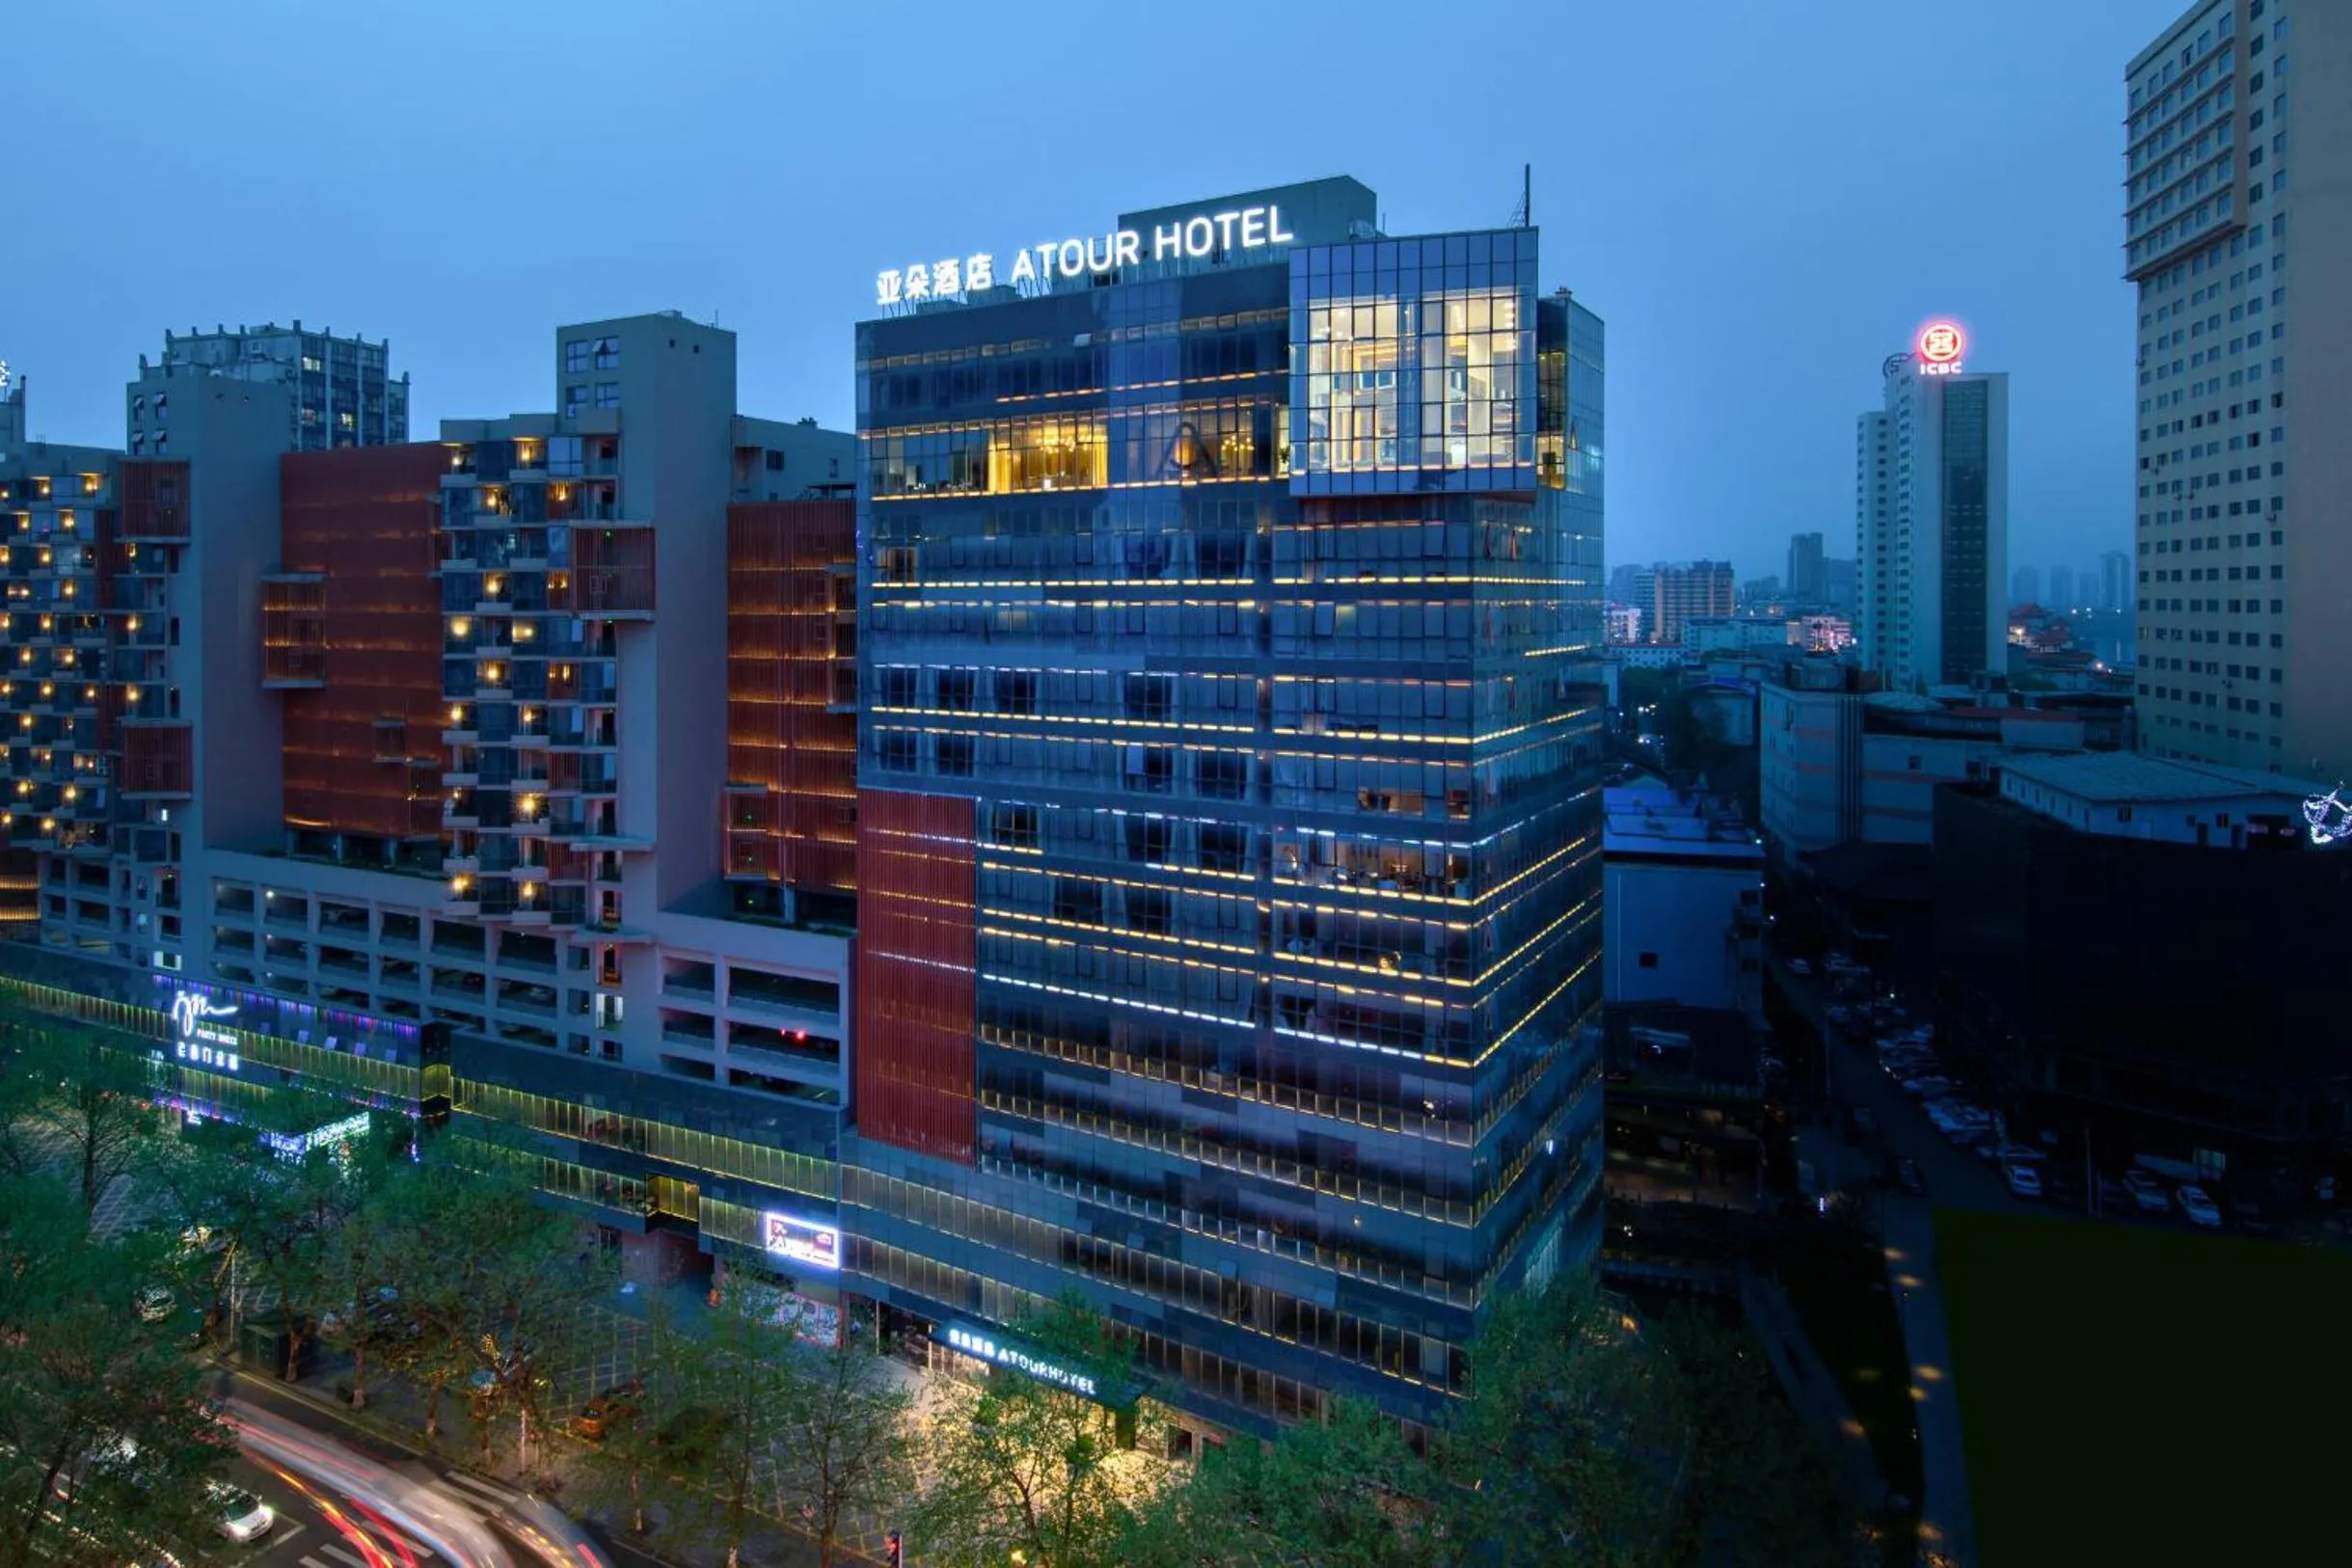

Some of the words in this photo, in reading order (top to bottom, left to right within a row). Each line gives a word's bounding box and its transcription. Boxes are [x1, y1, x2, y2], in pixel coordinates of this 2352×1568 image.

[876, 252, 993, 305] 亚朵酒店
[1011, 230, 1139, 283] ATOUR
[1155, 204, 1294, 260] HOTEL
